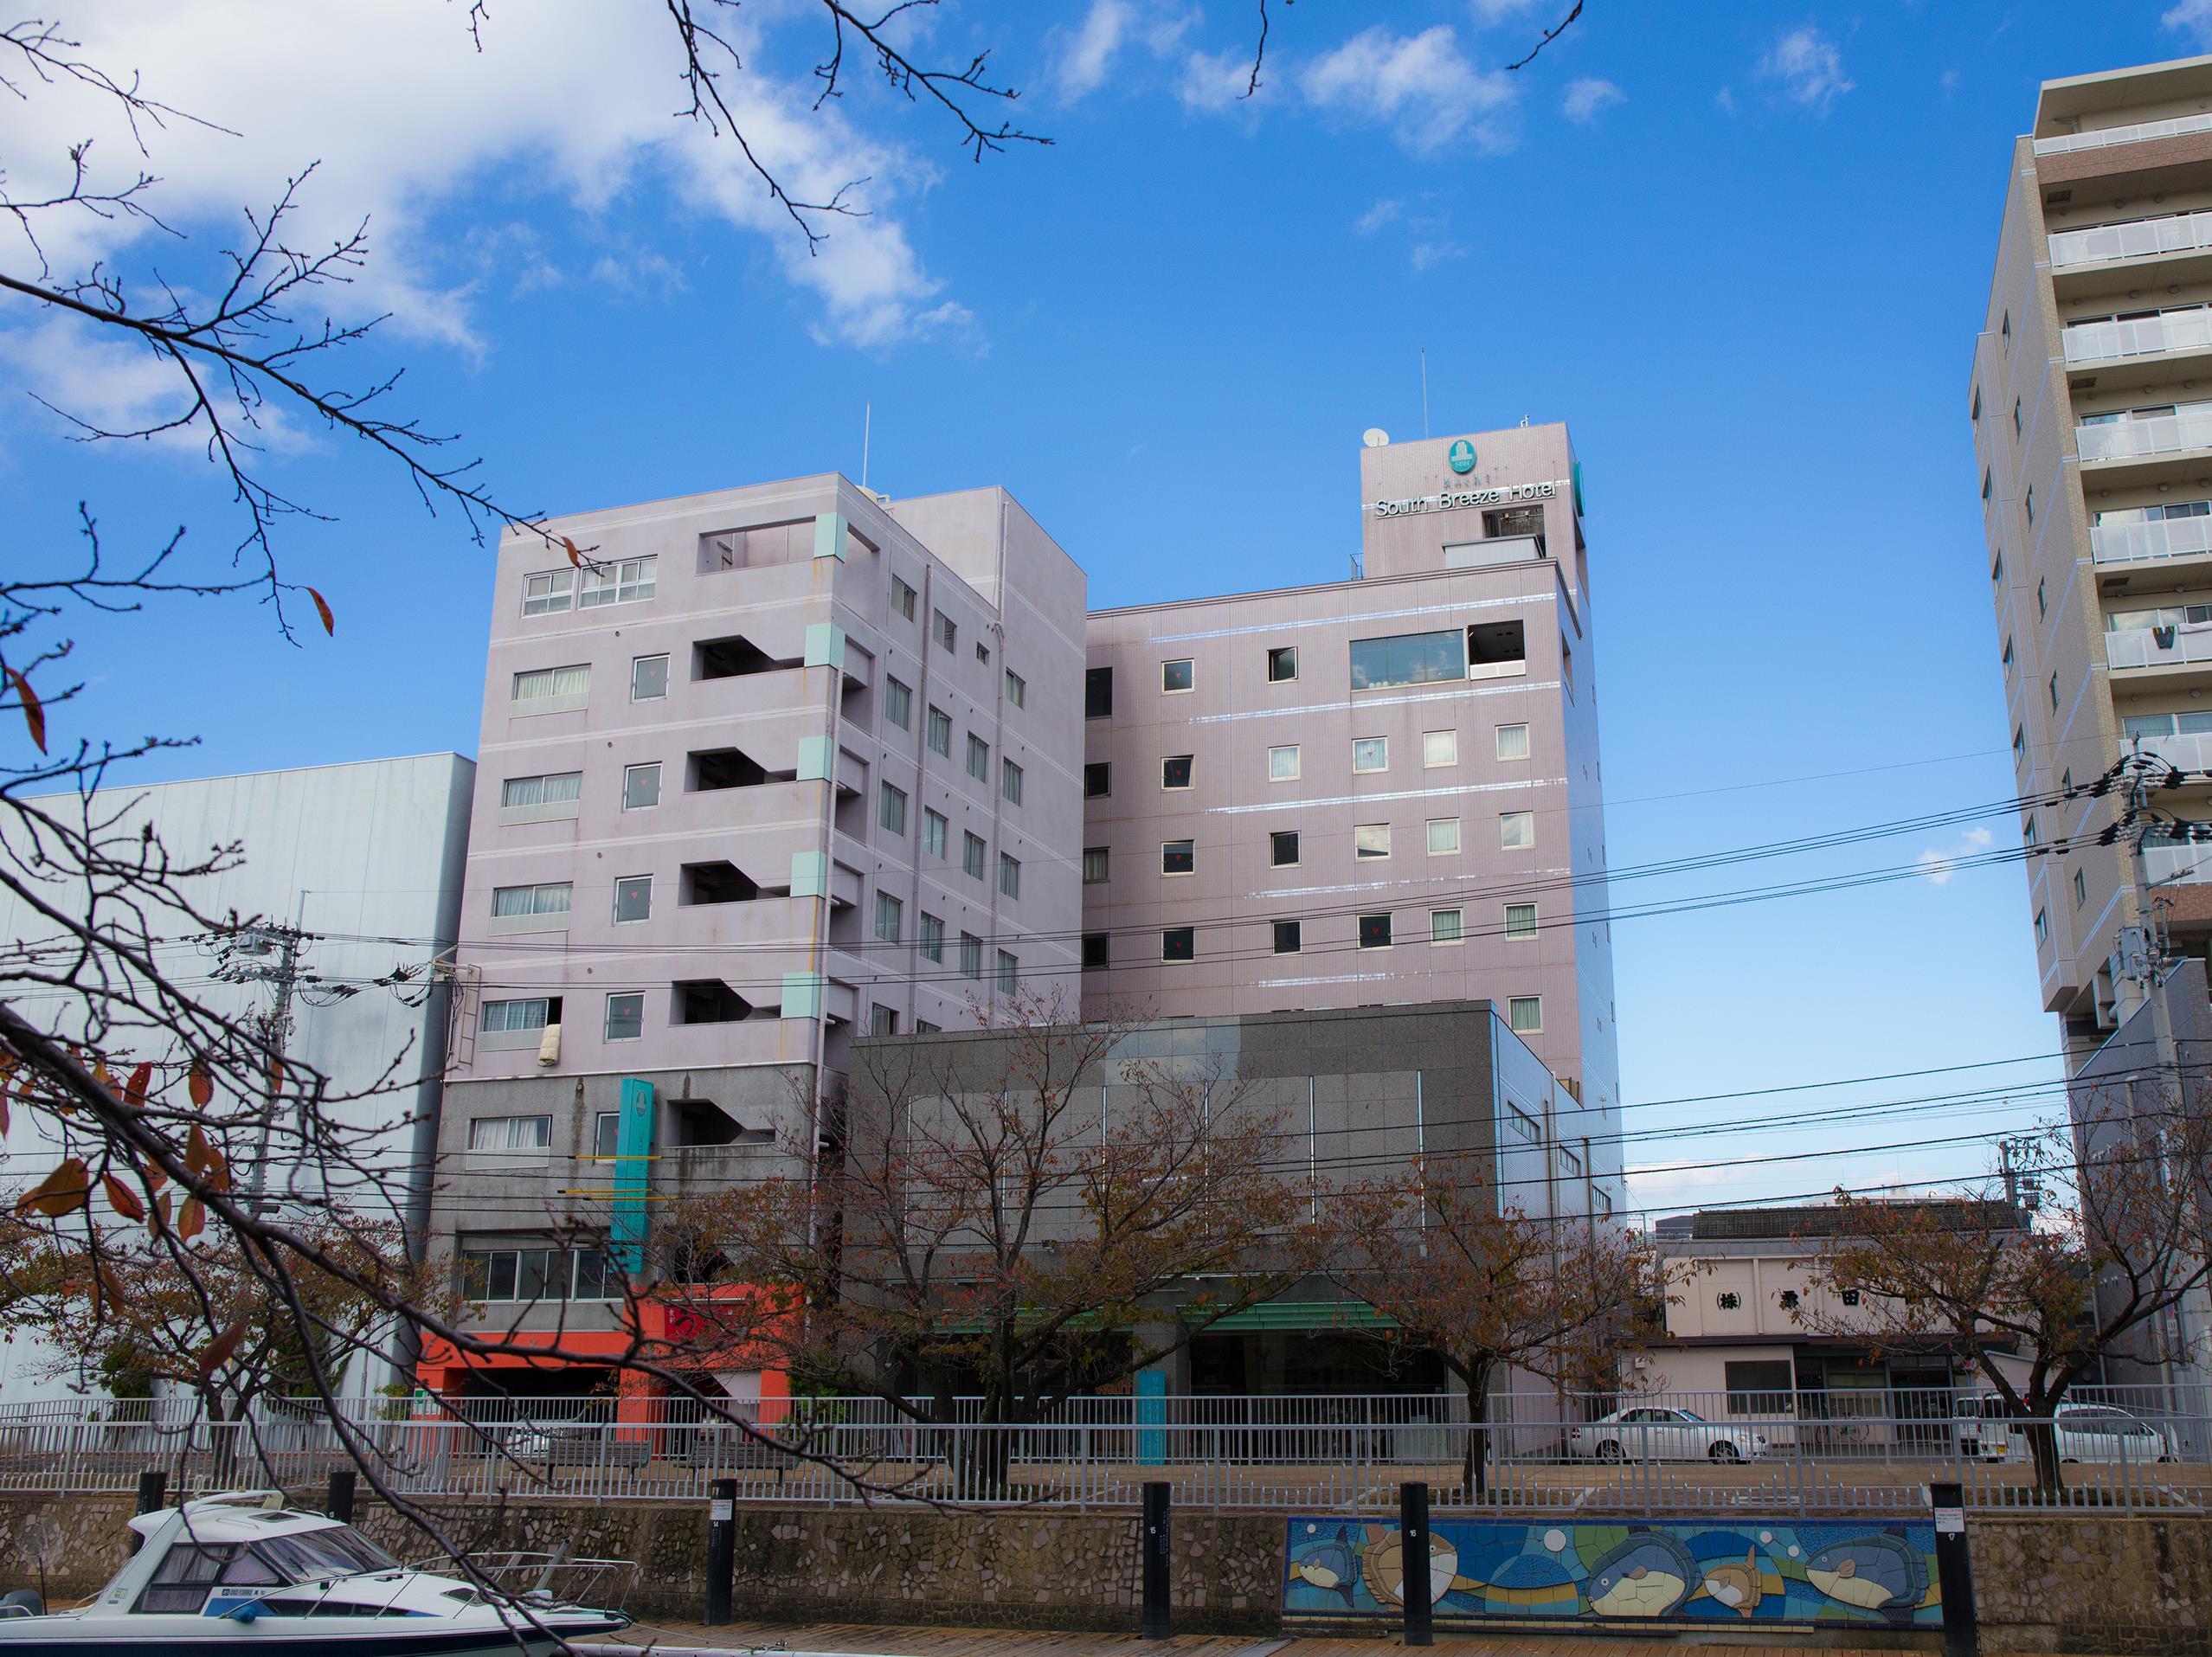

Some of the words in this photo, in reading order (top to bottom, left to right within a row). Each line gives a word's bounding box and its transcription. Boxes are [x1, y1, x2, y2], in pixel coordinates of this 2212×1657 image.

[1376, 494, 1428, 517] South
[1439, 491, 1500, 510] Breeze
[1508, 478, 1556, 501] Hotel
[1149, 1526, 1157, 1535] 15
[1948, 1532, 1956, 1541] 17
